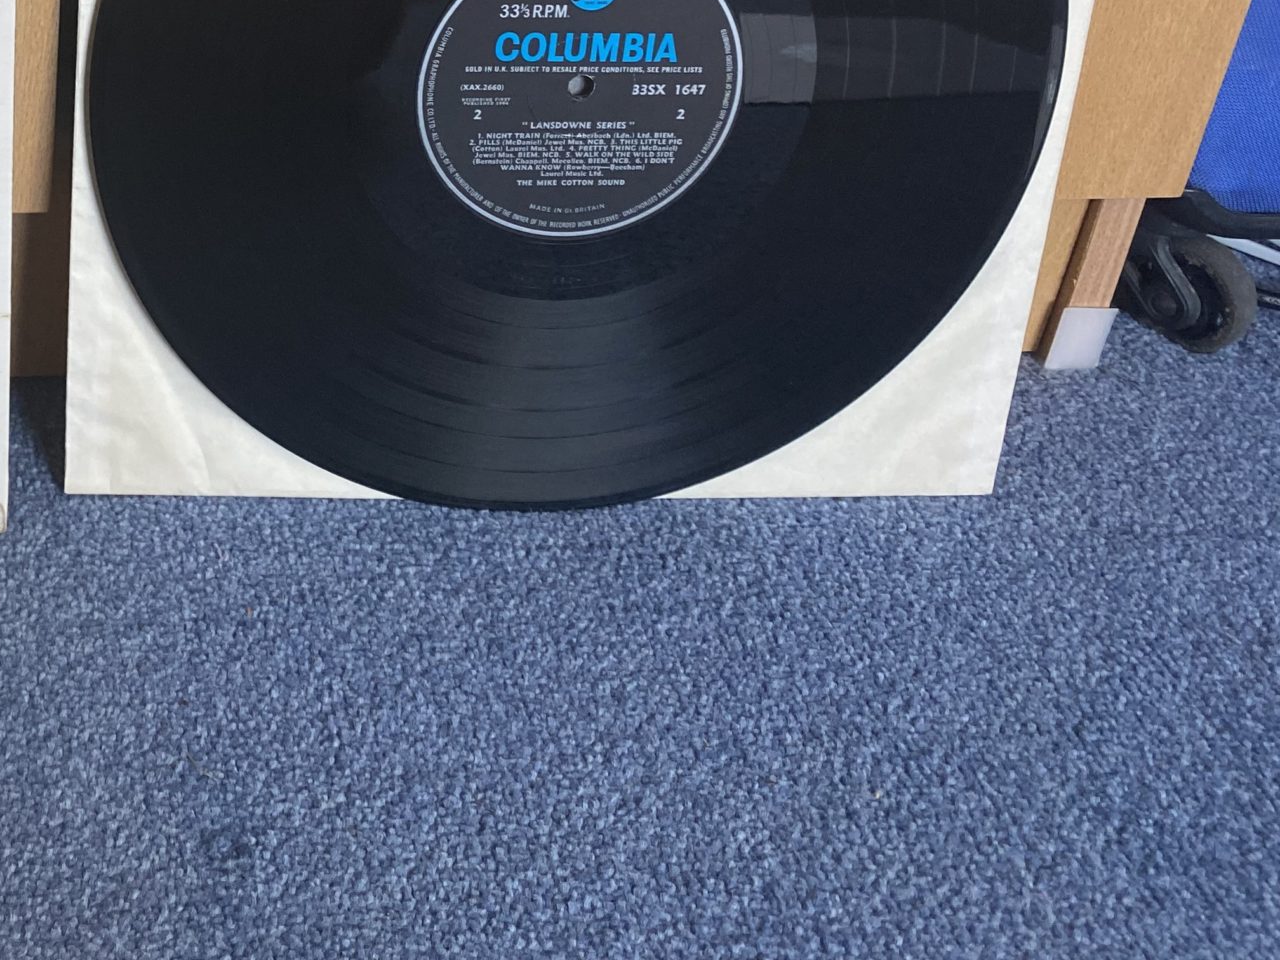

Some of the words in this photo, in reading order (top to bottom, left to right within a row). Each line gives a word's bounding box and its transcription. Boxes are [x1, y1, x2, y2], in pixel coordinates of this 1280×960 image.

[533, 5, 570, 18] R.P.M.
[496, 32, 676, 62] COLUMBIA
[632, 84, 666, 95] 33SX
[676, 84, 706, 95] 1647
[473, 109, 481, 120] 2
[676, 109, 685, 119] 2
[530, 121, 591, 129] LANSDOWNE
